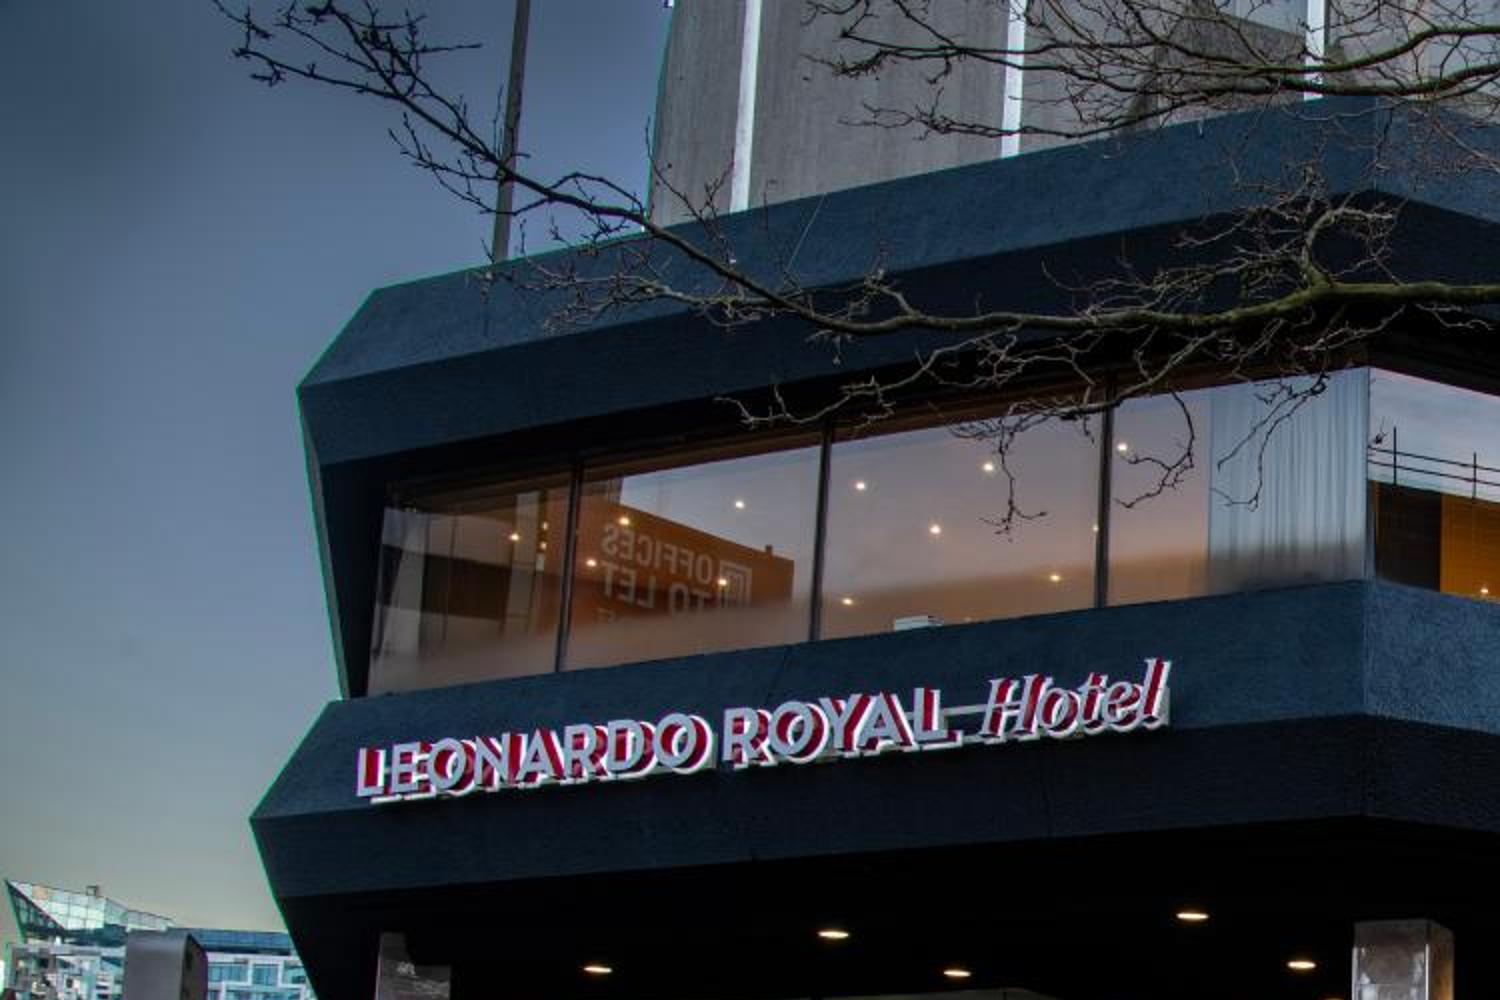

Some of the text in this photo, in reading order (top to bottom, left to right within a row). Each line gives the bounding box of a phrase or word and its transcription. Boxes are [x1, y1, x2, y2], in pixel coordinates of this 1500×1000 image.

[356, 659, 1170, 804] LEONARDO ROYAL Hotel
